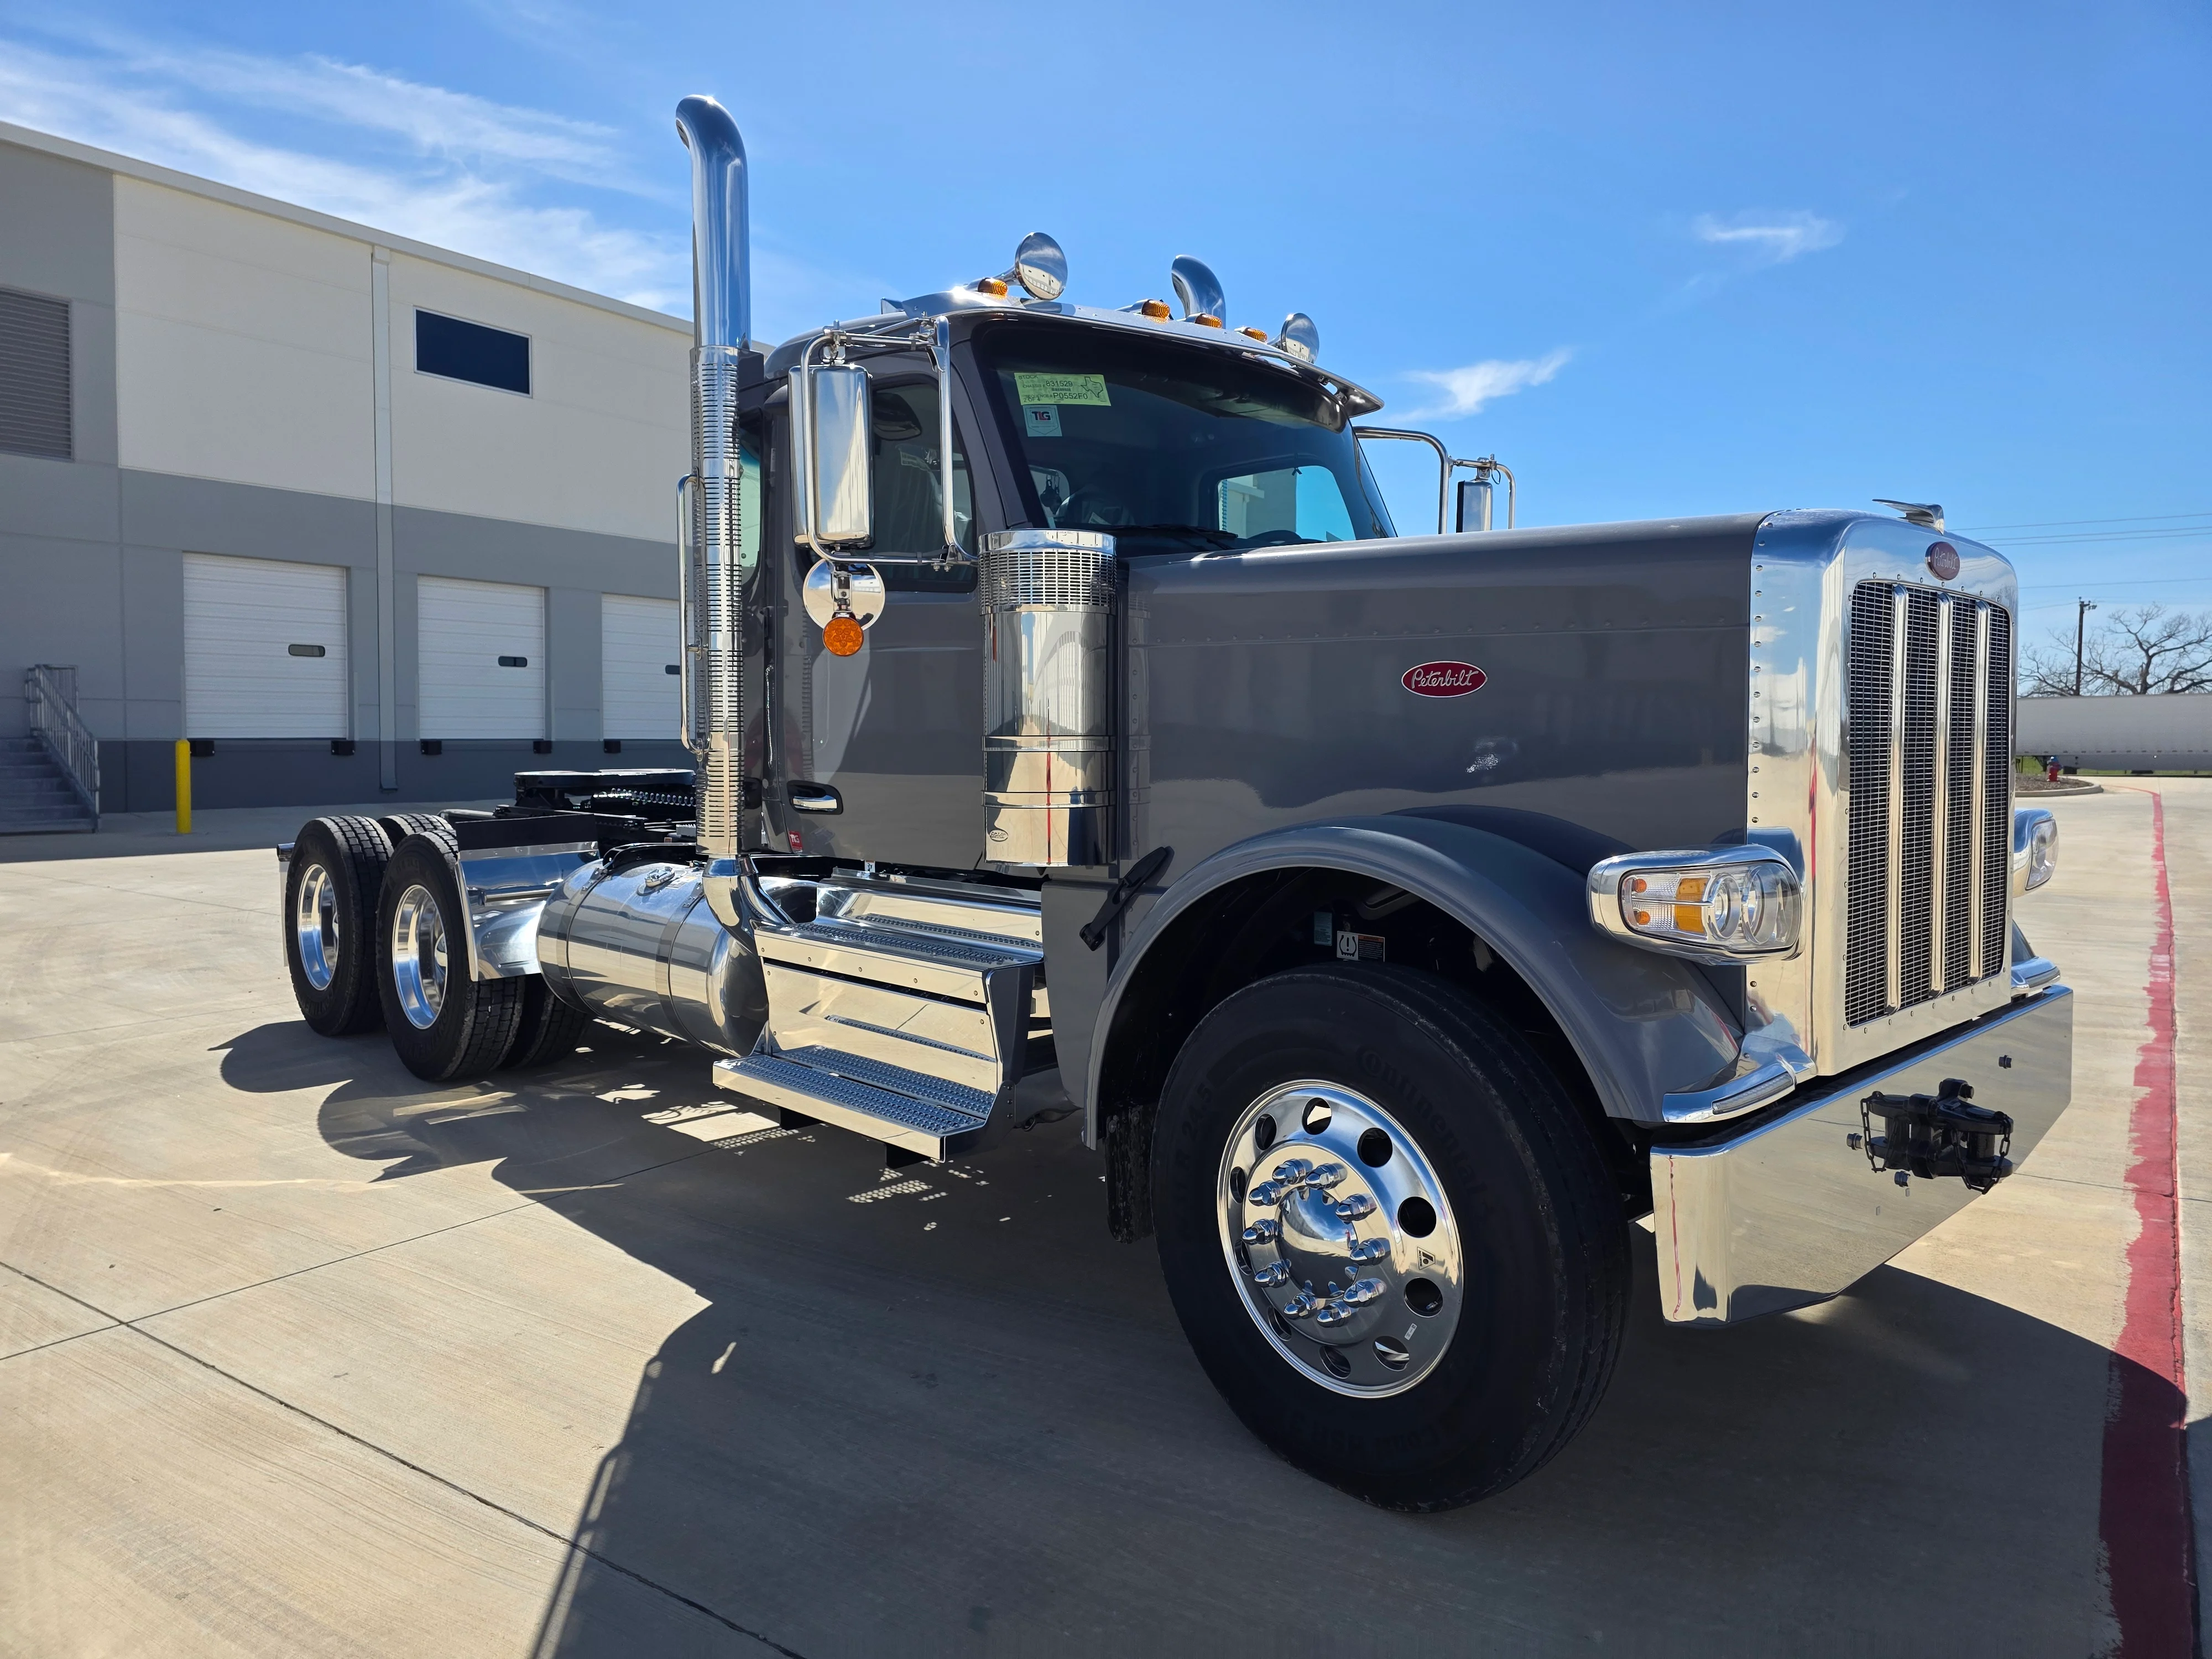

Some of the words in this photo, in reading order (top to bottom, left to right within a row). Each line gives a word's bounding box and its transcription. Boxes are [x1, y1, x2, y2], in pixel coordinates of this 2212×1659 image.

[1031, 411, 1051, 420] TLG
[1934, 547, 1958, 570] Peterbilt
[1411, 668, 1479, 689] Peterbilt
[1354, 1044, 1488, 1195] Continental
